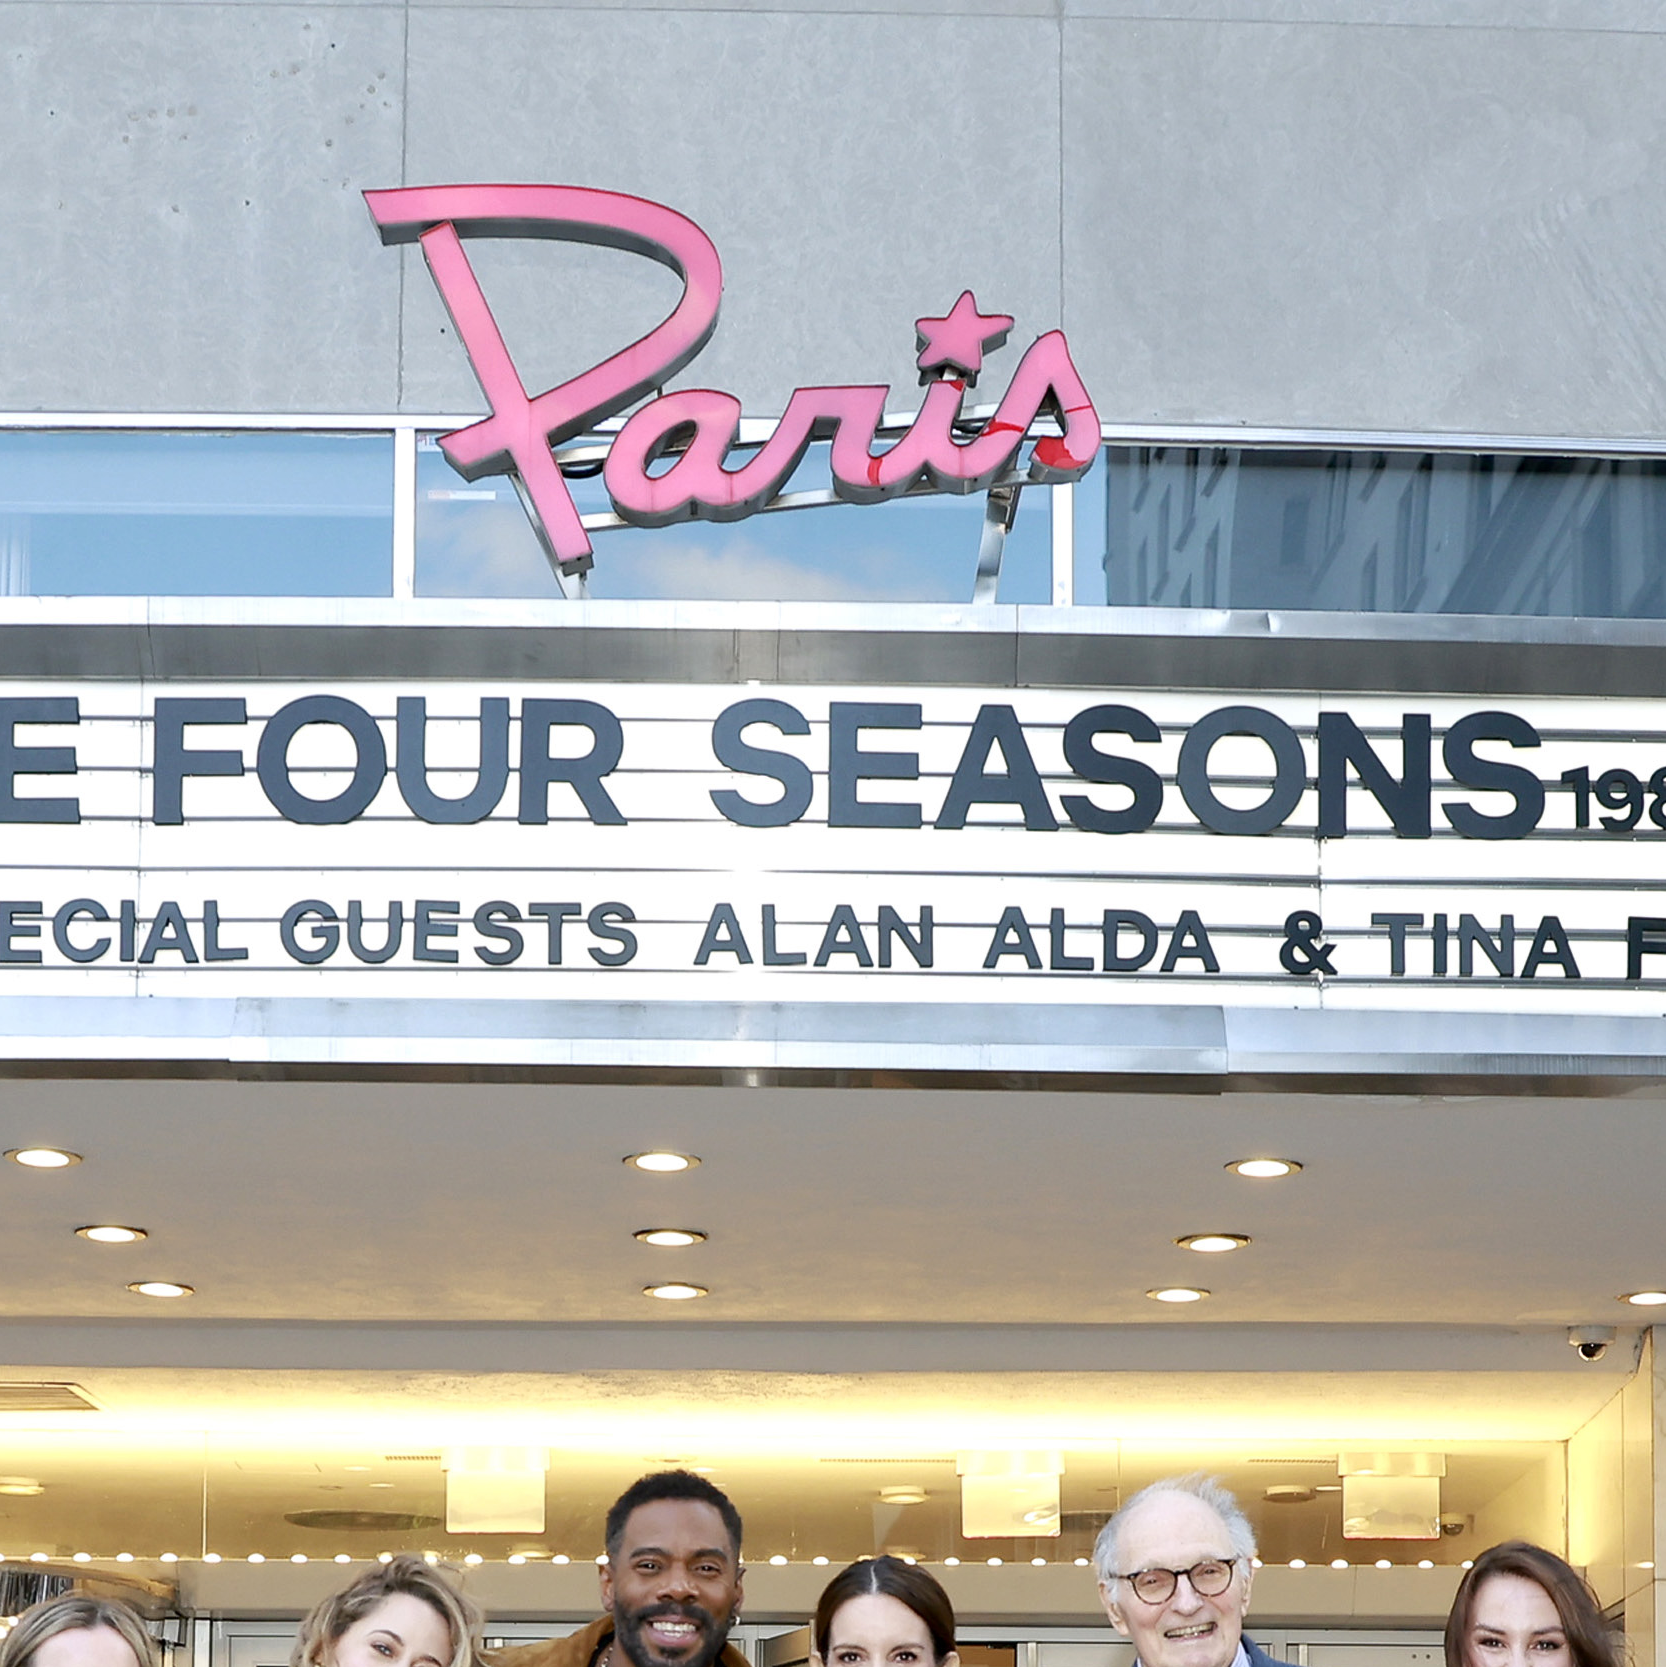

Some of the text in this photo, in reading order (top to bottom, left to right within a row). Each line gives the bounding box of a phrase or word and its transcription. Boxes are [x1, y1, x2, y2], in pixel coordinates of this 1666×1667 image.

[362, 183, 1102, 577] Paris
[153, 694, 627, 826] FOUR
[709, 698, 1545, 840] SEASONS
[280, 900, 637, 966] GUESTS
[693, 903, 933, 968] ALAN
[982, 906, 1220, 973] ALDA
[1279, 911, 1336, 976] &
[1371, 912, 1580, 979] TINA
